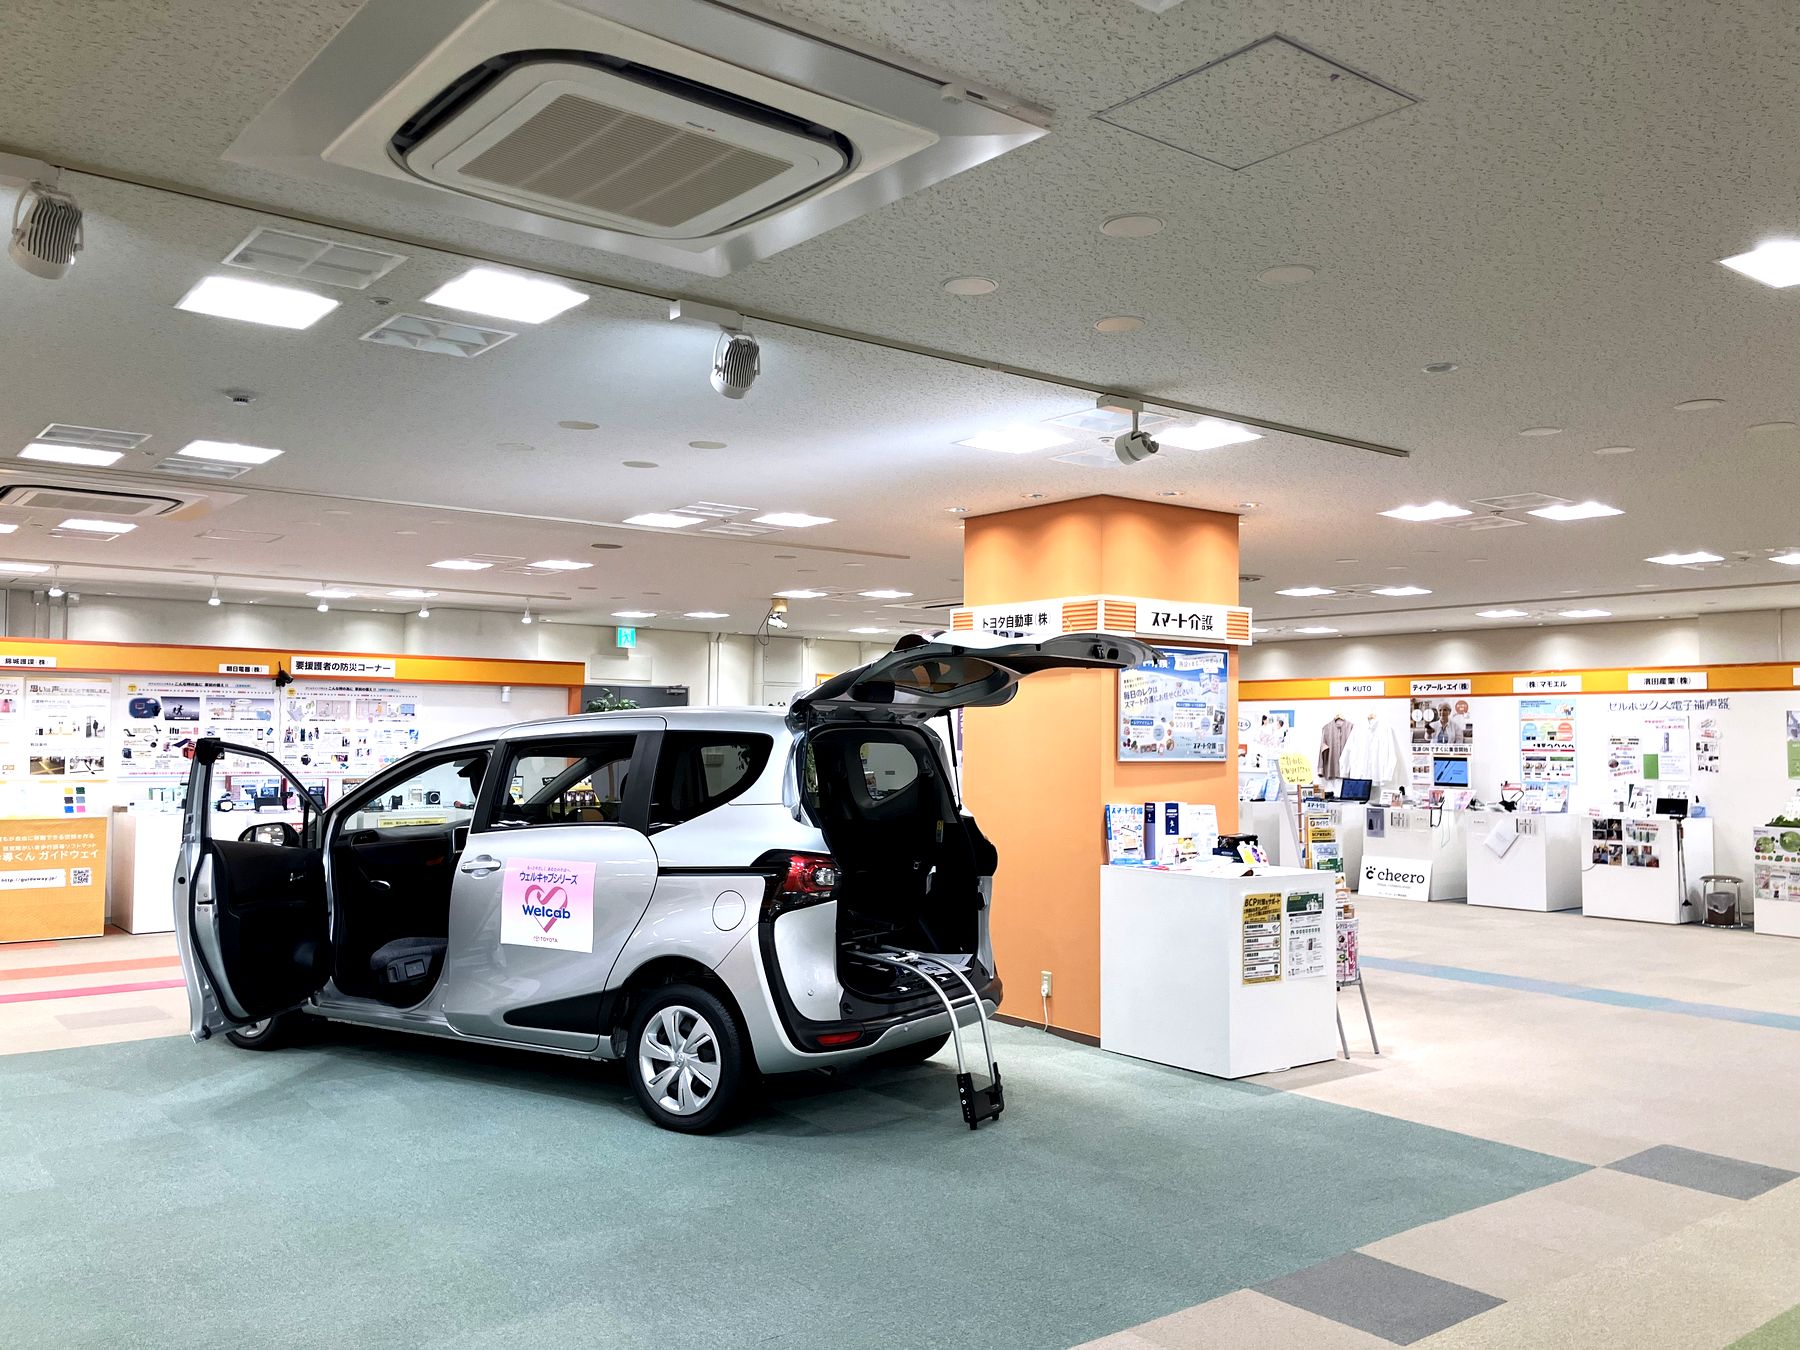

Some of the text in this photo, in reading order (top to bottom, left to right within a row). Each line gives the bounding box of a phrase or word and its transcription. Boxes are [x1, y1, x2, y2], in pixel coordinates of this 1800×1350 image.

[1151, 611, 1213, 631] スマート介護
[295, 660, 391, 672] 要援護者の防災コーナー
[39, 849, 98, 860] ガイドウェイ
[520, 872, 578, 884] ウェルキャブシリーズ
[1377, 868, 1425, 884] cheero
[522, 904, 571, 919] Welcab
